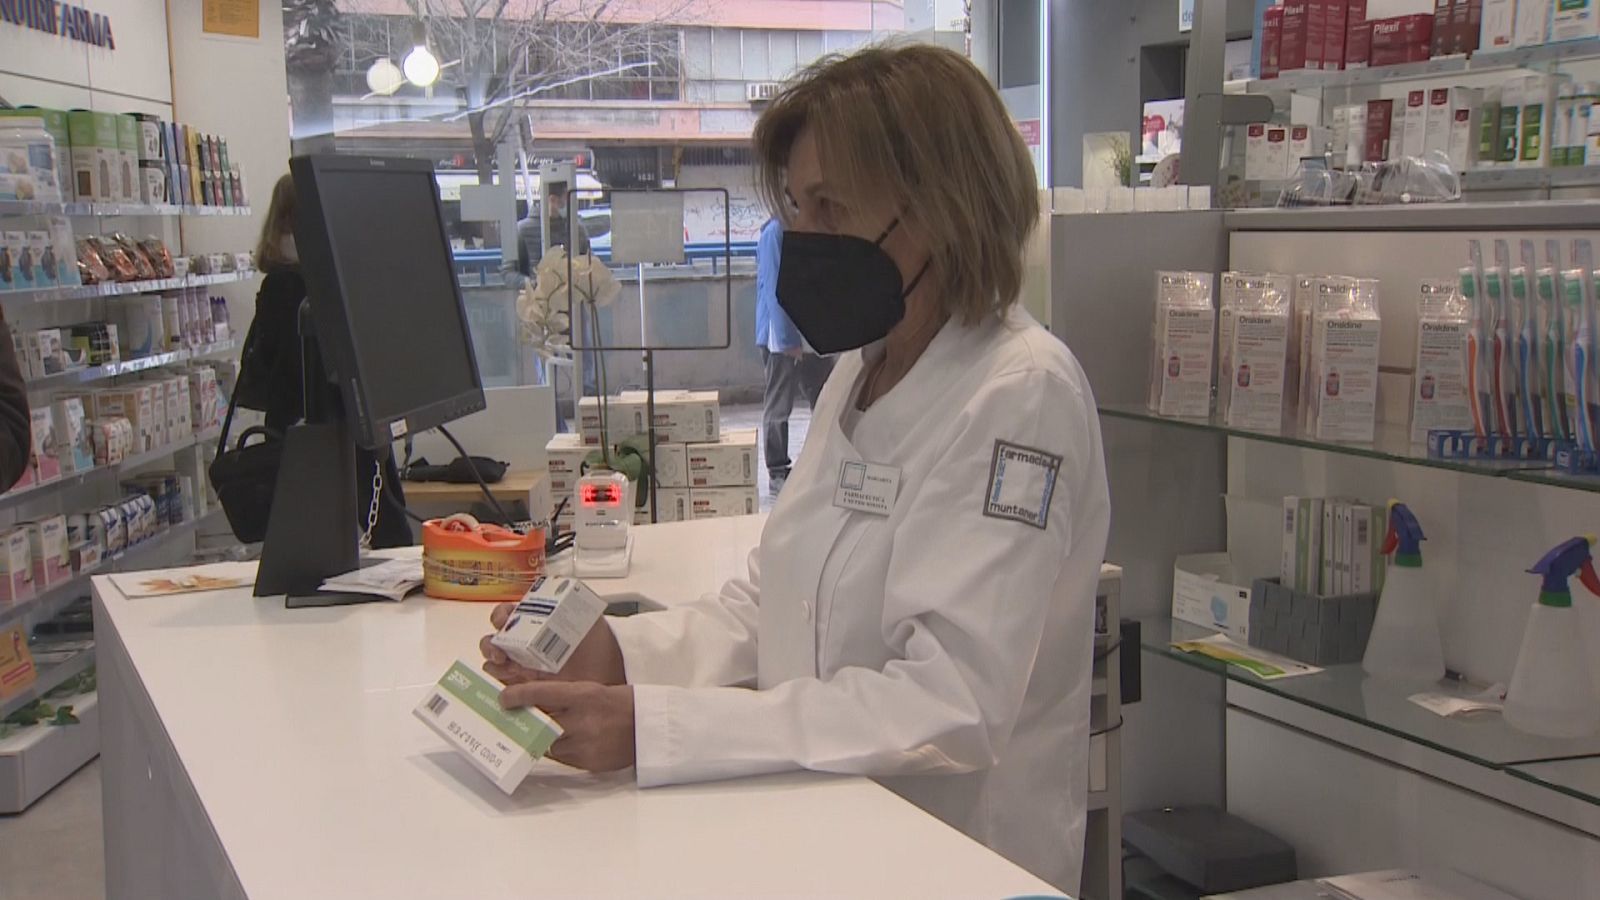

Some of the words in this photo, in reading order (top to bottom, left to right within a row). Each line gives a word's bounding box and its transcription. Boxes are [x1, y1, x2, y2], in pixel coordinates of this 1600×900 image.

[1373, 21, 1400, 35] Pilexil
[1328, 320, 1362, 329] Oraldine
[989, 502, 1039, 521] muntaner
